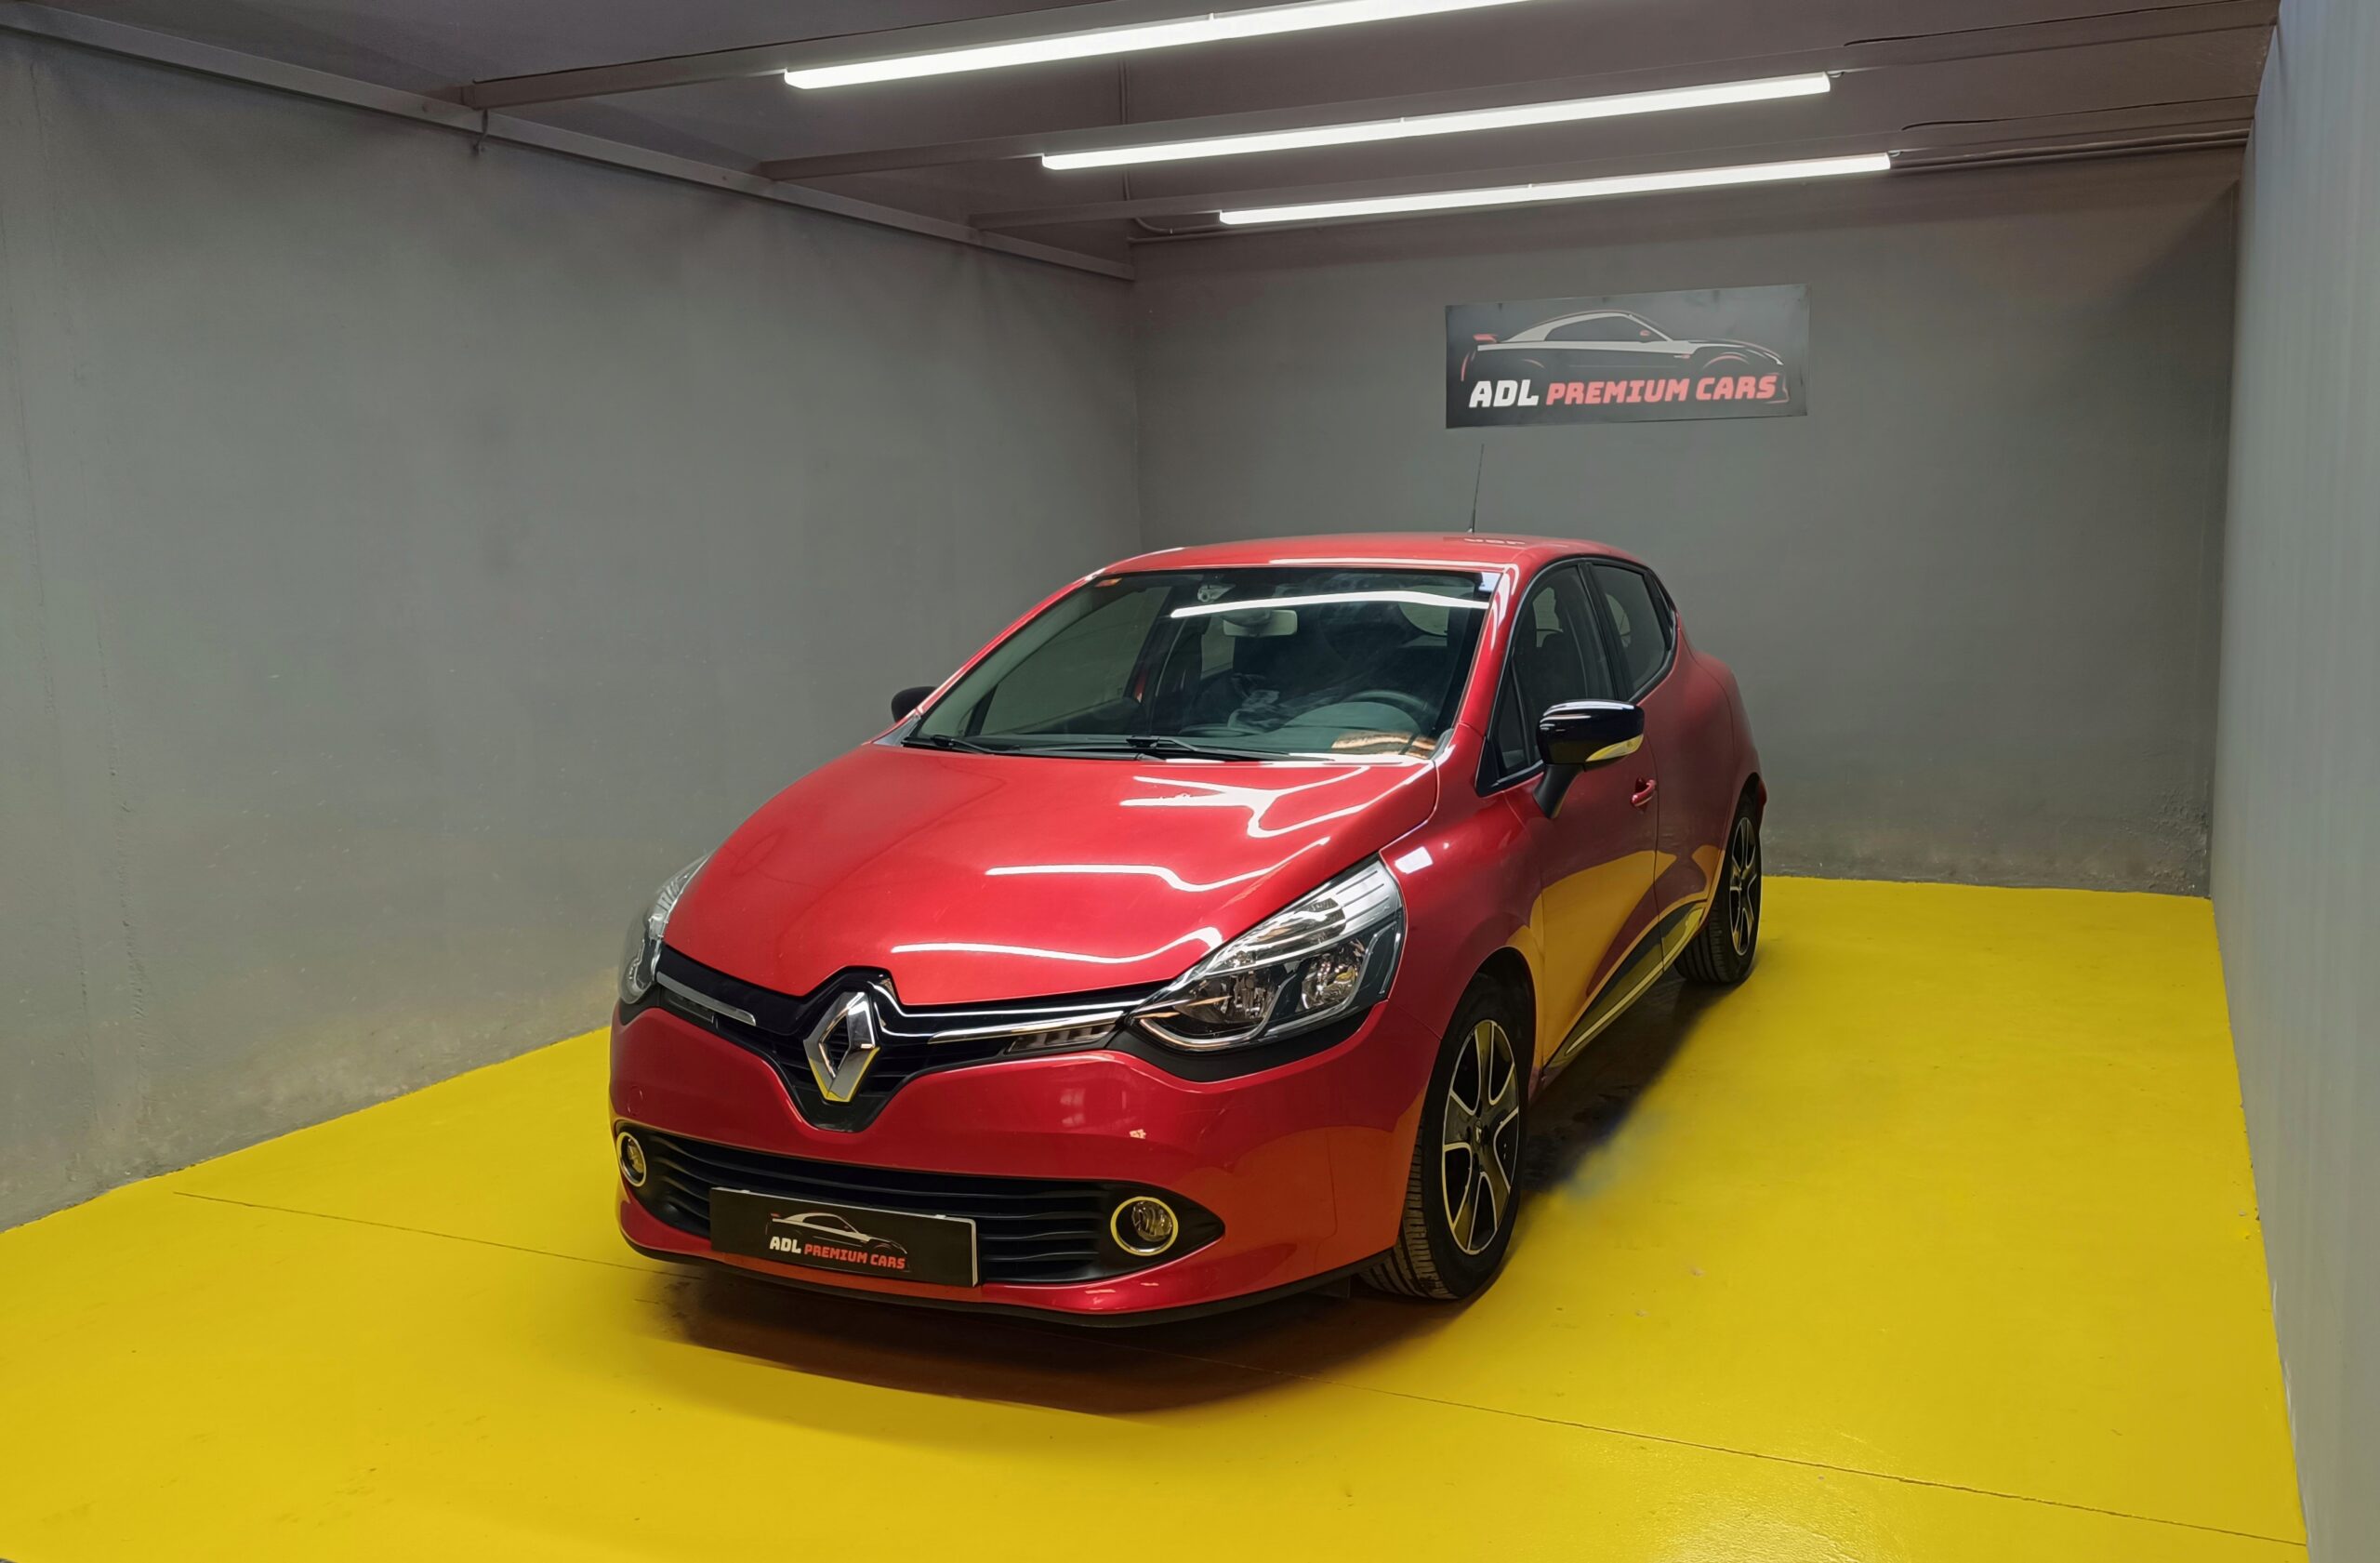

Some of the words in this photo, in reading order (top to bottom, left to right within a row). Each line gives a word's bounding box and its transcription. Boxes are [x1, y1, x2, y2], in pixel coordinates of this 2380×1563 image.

[1469, 379, 1540, 407] ADL
[1546, 378, 1690, 405] PREMIUM
[1696, 376, 1778, 401] CARS
[770, 1236, 801, 1254] ADL
[804, 1243, 868, 1264] PREMIUM
[870, 1254, 906, 1269] CARS
